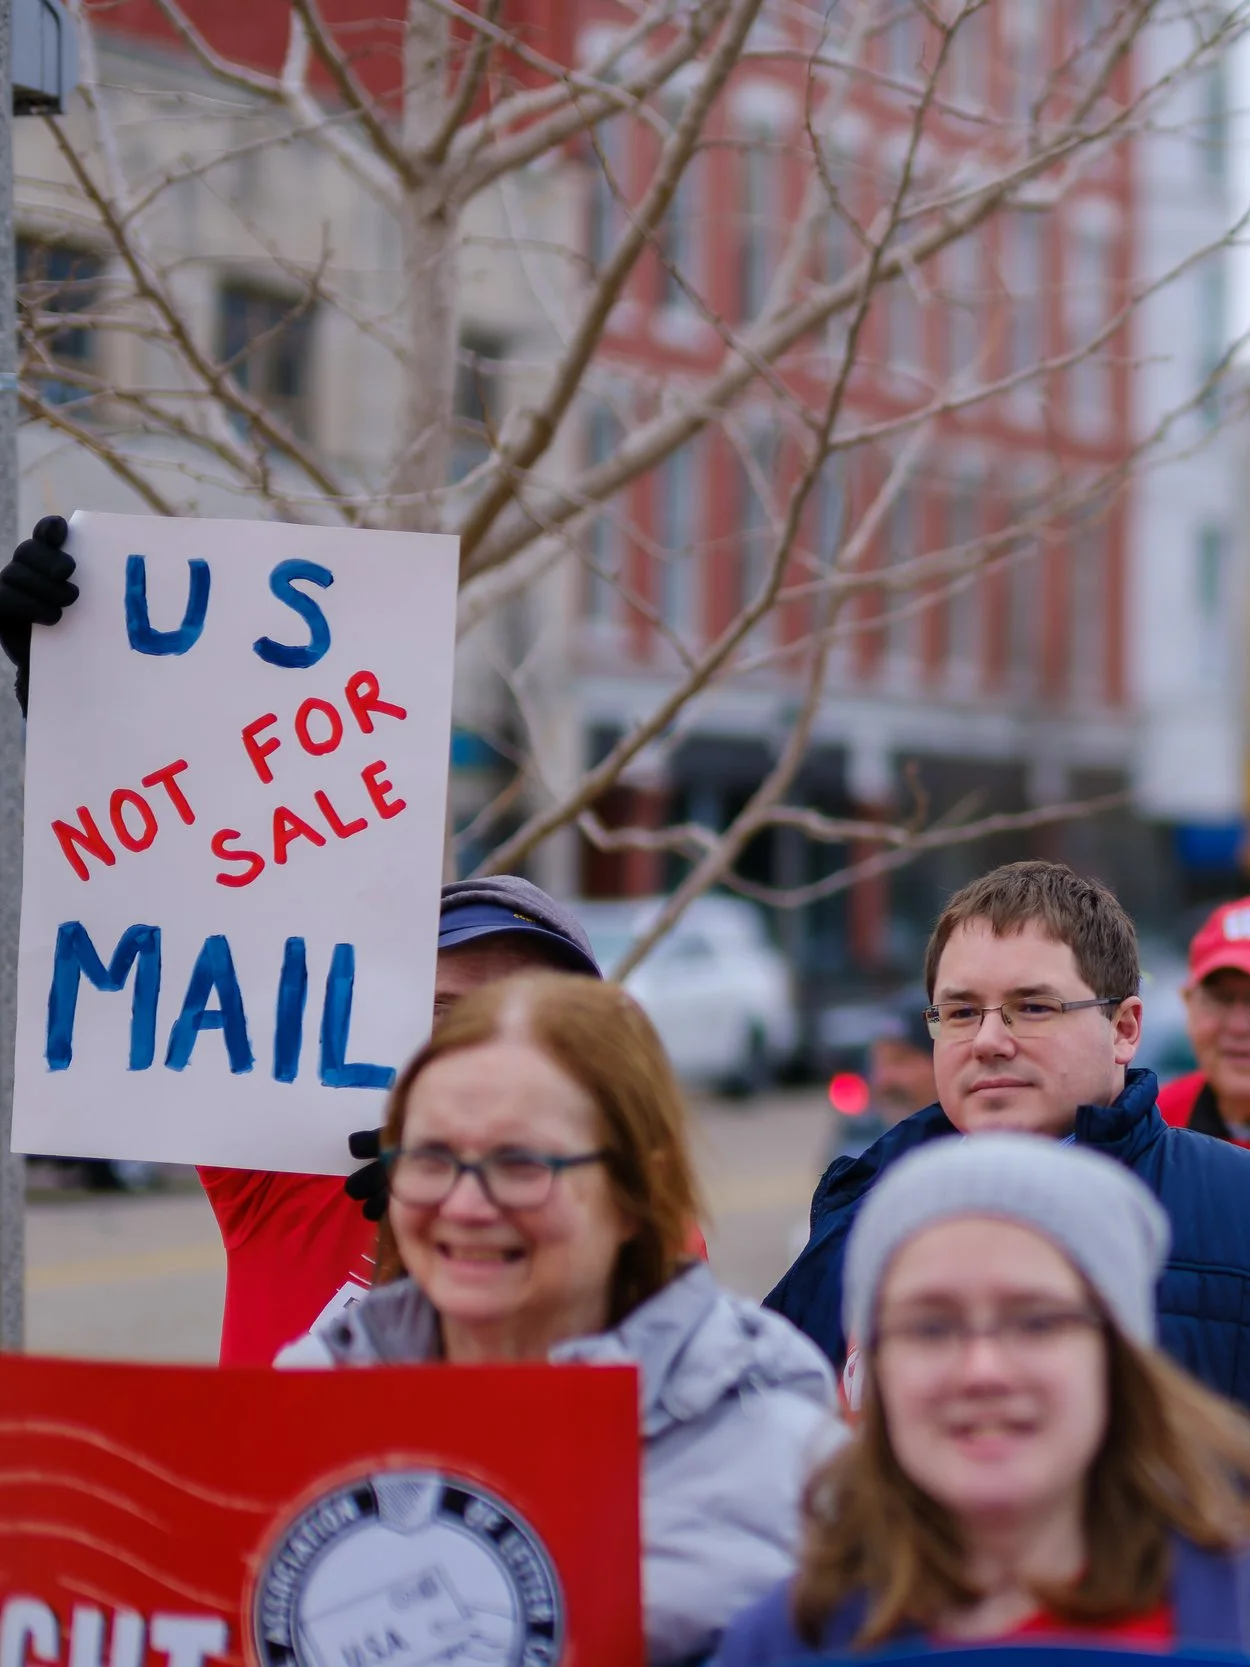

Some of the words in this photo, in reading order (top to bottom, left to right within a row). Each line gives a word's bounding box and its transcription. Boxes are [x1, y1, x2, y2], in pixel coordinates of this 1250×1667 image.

[51, 759, 196, 882] NOT
[242, 670, 407, 784] FOR
[210, 760, 407, 888] SALE
[45, 920, 397, 1090] MAIL
[262, 1495, 359, 1646] ASSOCIATION
